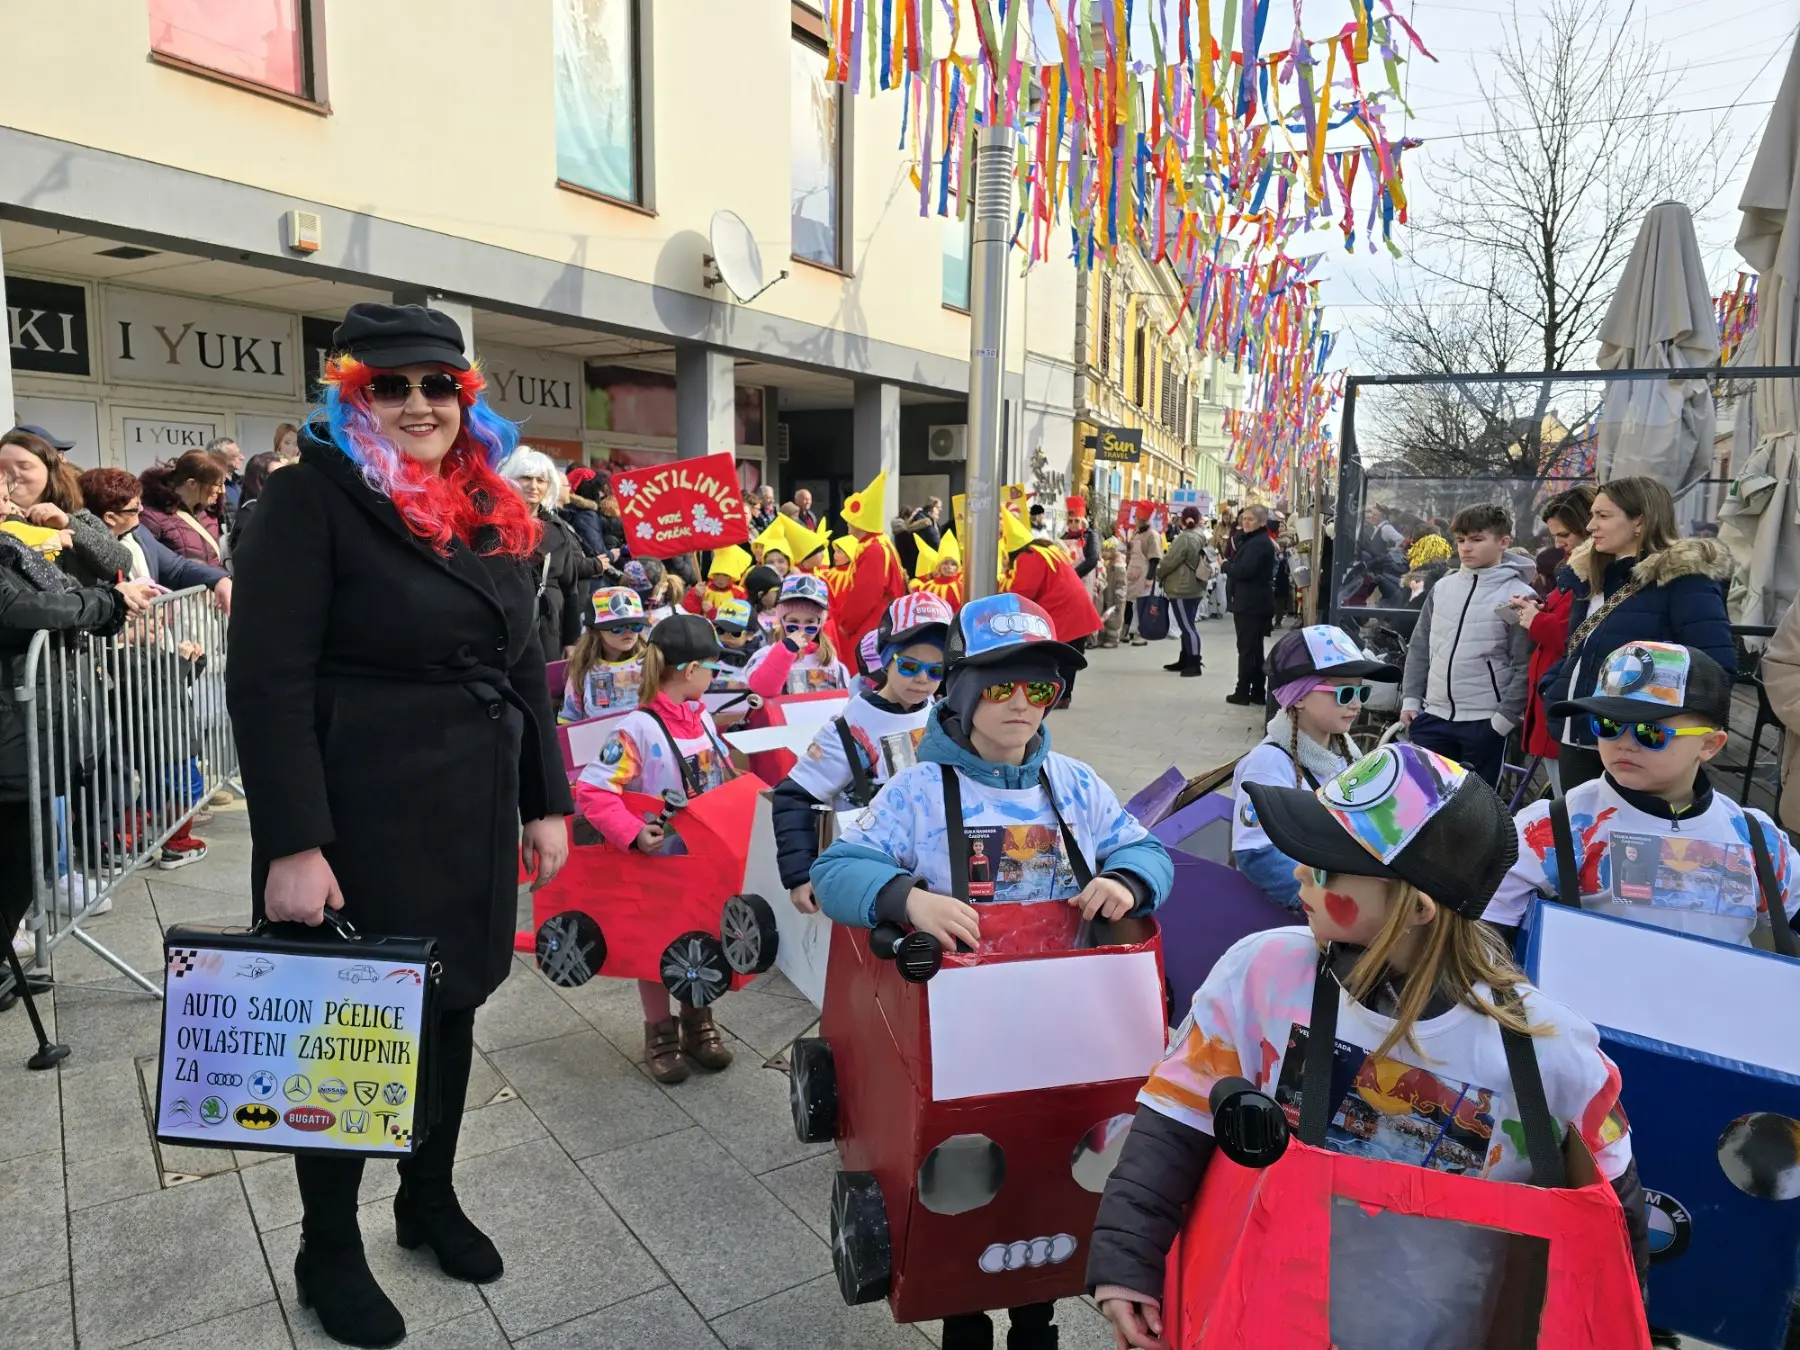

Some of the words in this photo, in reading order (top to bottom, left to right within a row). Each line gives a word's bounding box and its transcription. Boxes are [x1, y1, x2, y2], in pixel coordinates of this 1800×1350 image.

[117, 321, 136, 360] I
[152, 321, 285, 376] YUKI
[491, 368, 572, 409] YUKI
[136, 427, 143, 443] I
[150, 426, 204, 446] YUKI
[1103, 432, 1138, 454] Sun
[1104, 451, 1129, 460] TRAVEL
[182, 992, 237, 1019] AUTO
[248, 996, 314, 1024] SALON
[324, 998, 405, 1031] PČELICE
[177, 1025, 287, 1057] OVLAŠTENI
[297, 1034, 411, 1065] ZASTUPNIK
[175, 1057, 199, 1083] ZA
[319, 1086, 347, 1095] NISSAN
[289, 1112, 330, 1126] BUGATTI
